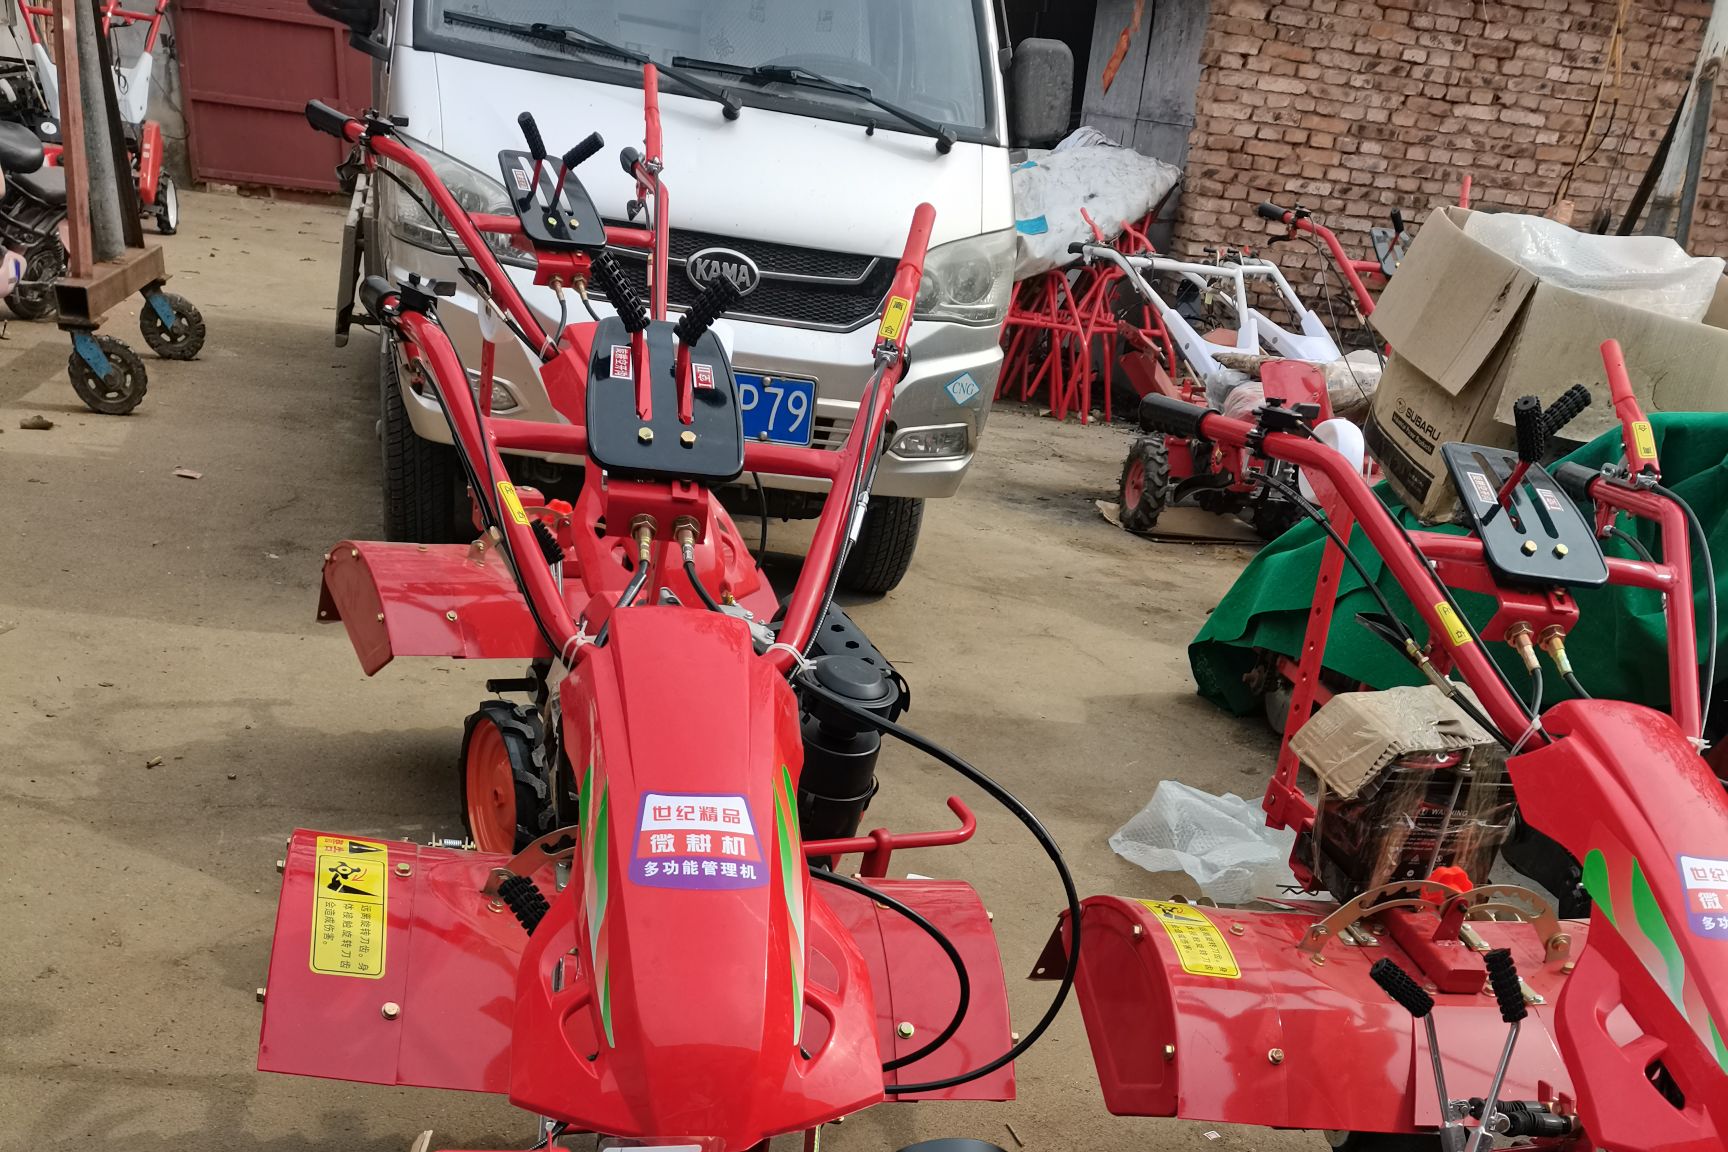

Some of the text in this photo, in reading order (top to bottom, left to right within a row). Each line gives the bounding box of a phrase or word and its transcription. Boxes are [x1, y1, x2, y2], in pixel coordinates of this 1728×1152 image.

[696, 259, 750, 287] KAMA
[952, 382, 974, 395] CNG
[1406, 408, 1441, 441] SUBARU
[653, 805, 740, 824] 世纪精品
[650, 834, 745, 856] 微耕机
[644, 860, 756, 879] 多功能管理机
[1690, 866, 1728, 882] 世纪
